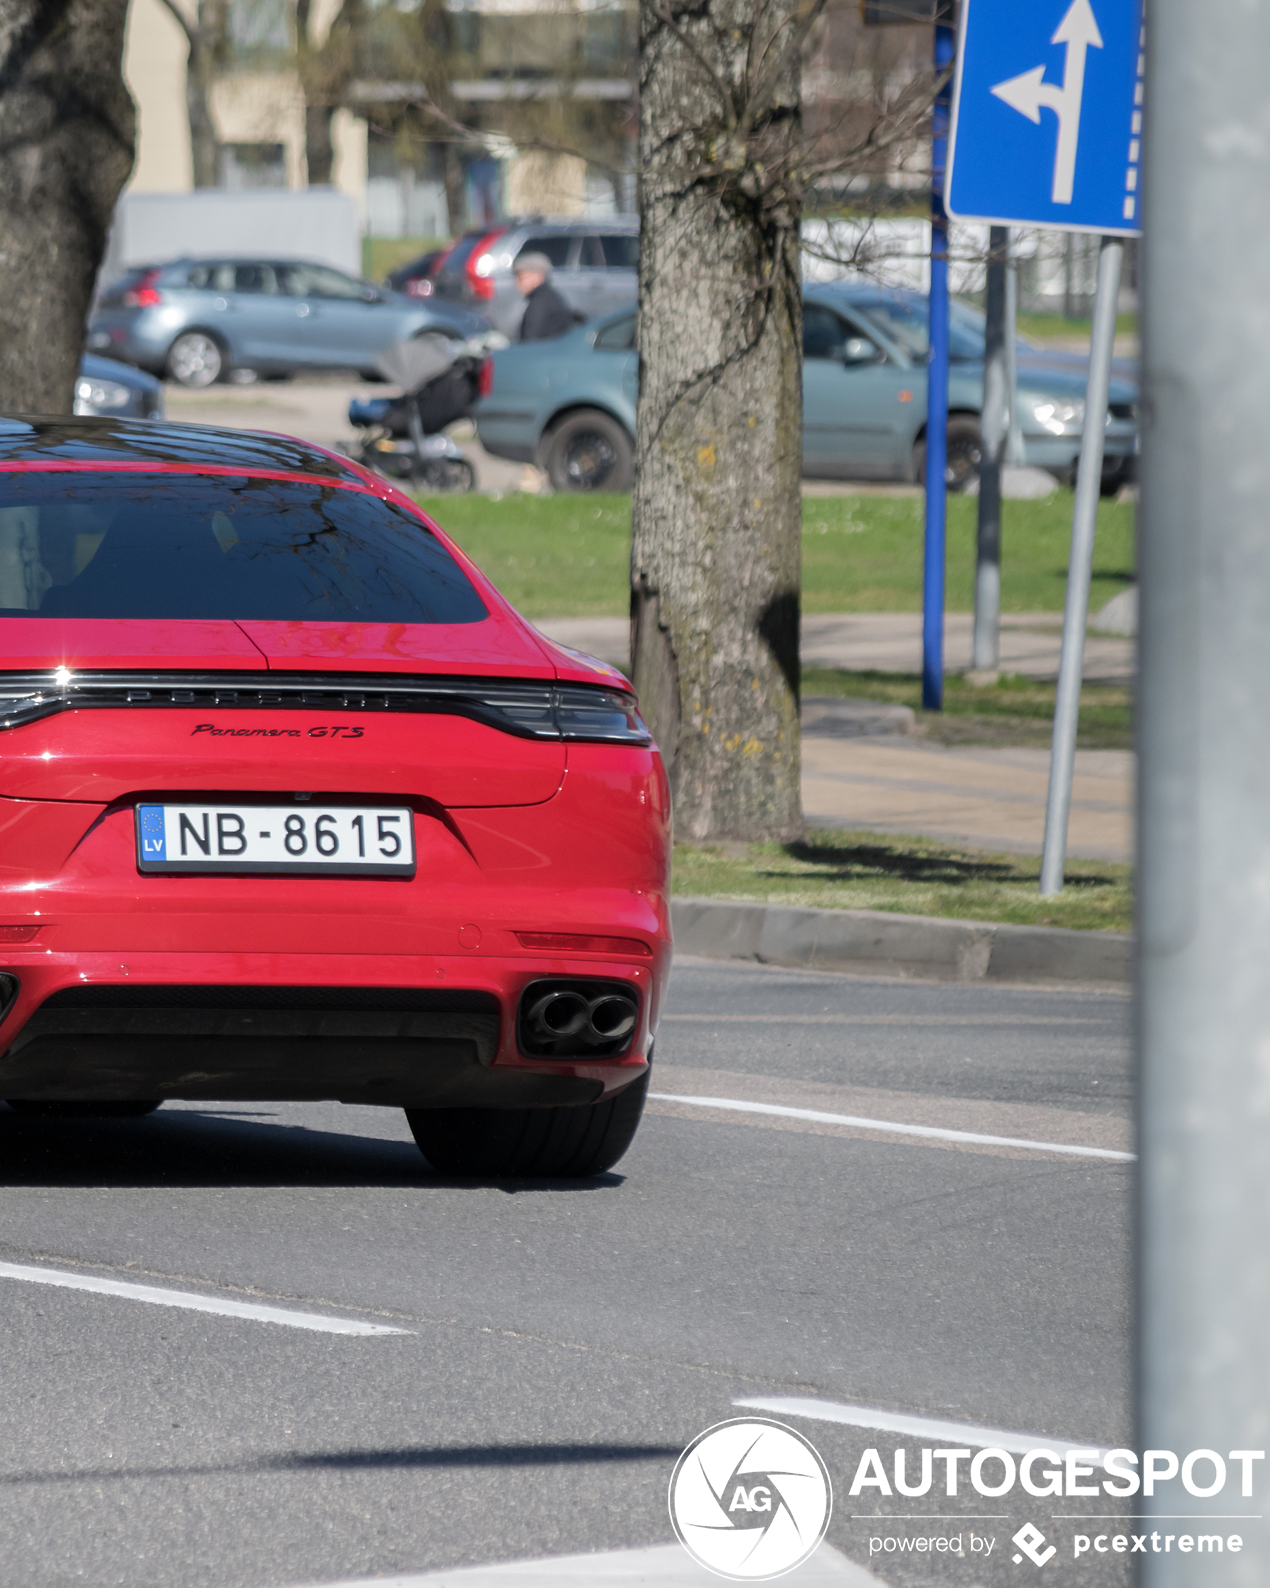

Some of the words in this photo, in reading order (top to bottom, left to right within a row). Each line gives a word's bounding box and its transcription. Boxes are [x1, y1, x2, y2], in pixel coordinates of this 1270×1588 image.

[127, 690, 409, 708] PORSCHE
[190, 724, 302, 738] Panamera
[307, 726, 365, 738] GTS
[178, 812, 402, 858] NB-8615
[144, 839, 163, 852] LV
